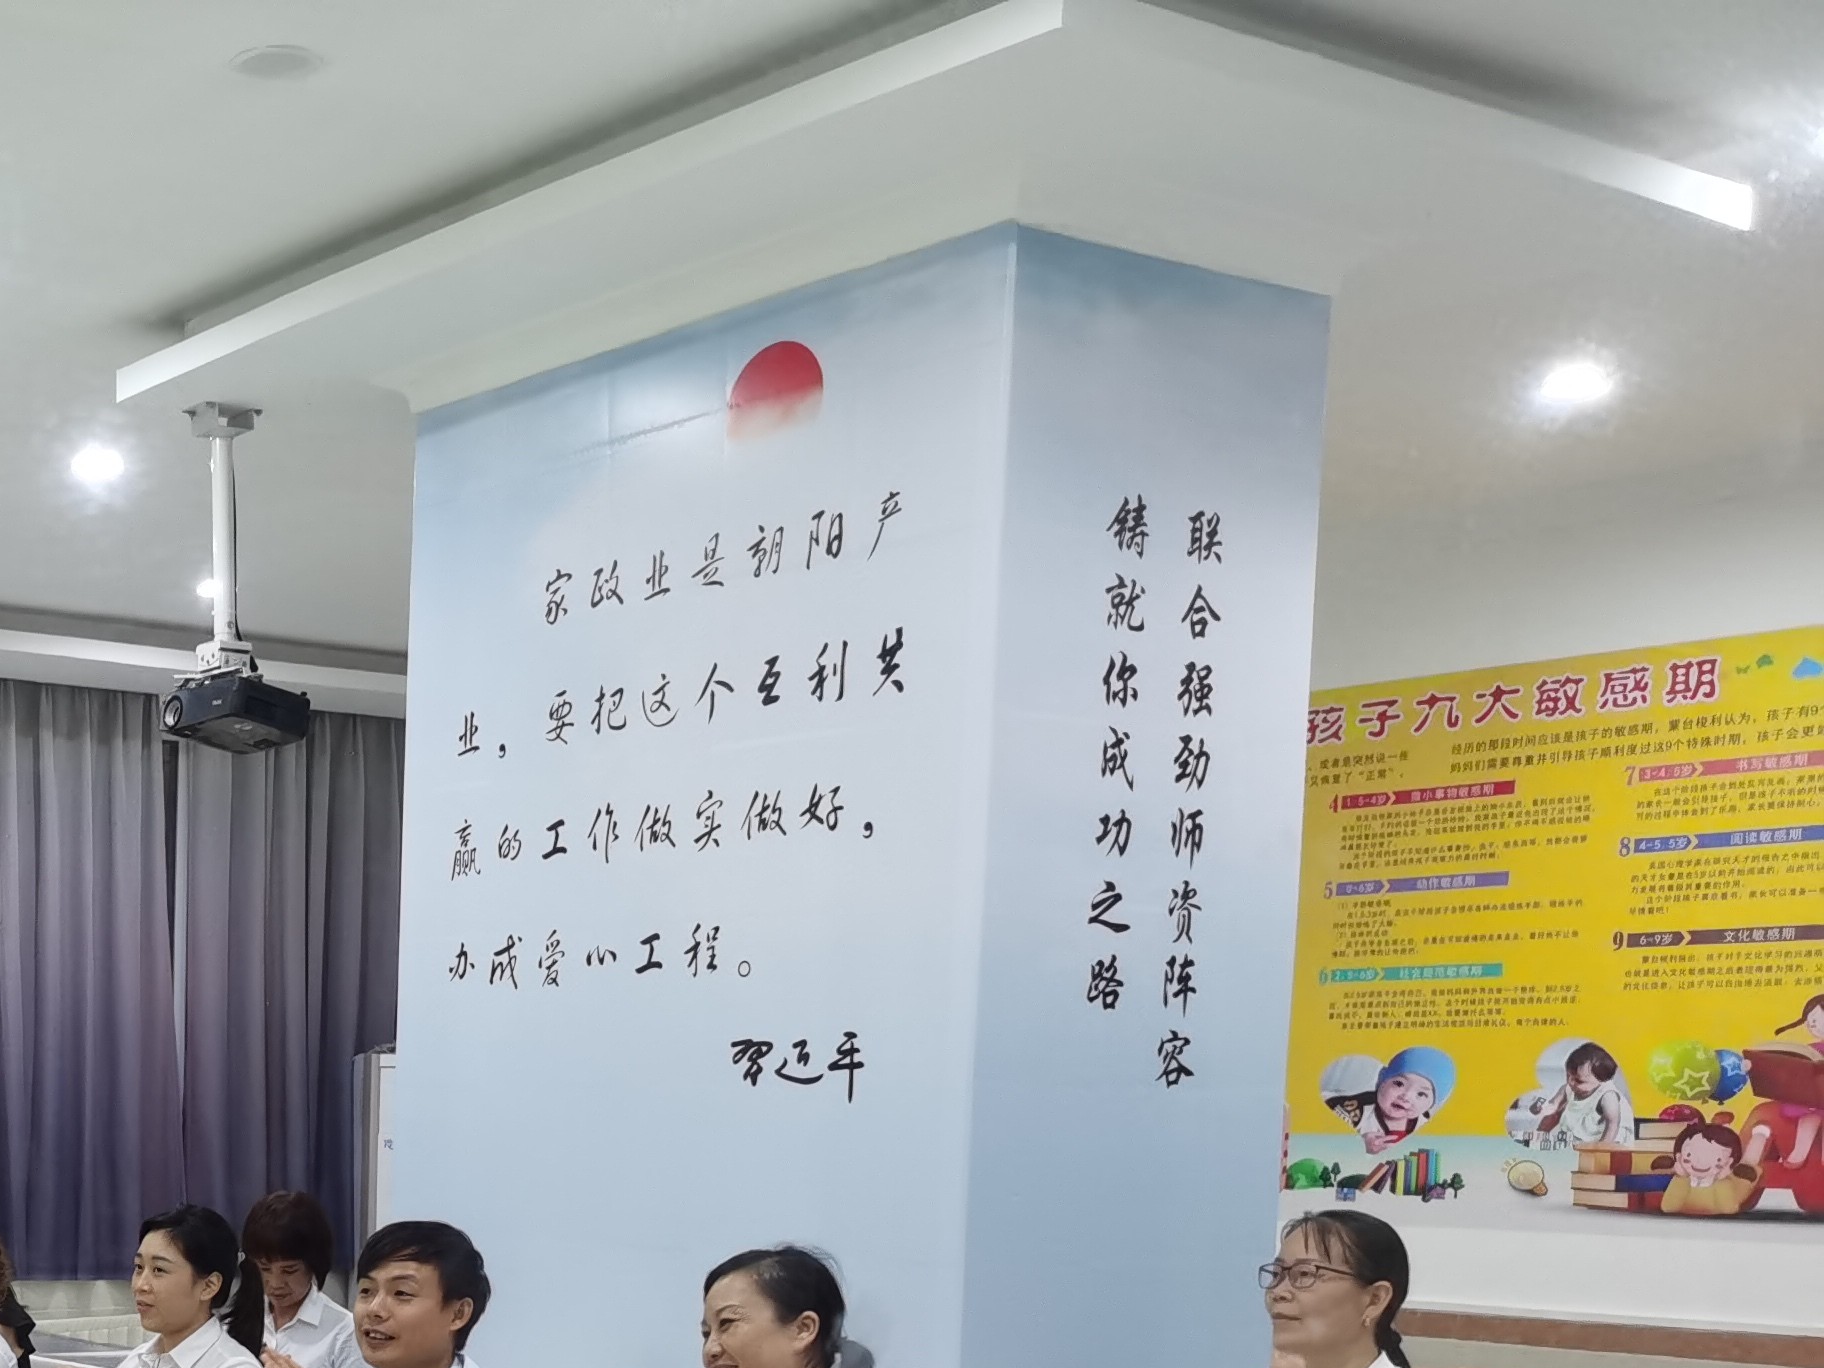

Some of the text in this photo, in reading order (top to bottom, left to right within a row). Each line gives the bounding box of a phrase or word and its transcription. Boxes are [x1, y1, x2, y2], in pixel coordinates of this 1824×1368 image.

[543, 490, 903, 626] 家政业是朝阳产
[457, 626, 905, 760] 业，要把这个互利共
[1307, 656, 1720, 746] 孩子九大敏感期
[1085, 492, 1150, 1011] 铸就你成功之路
[1735, 753, 1808, 771] 书写敏感期
[450, 782, 874, 882] 赢的工作做实做好，
[1154, 509, 1223, 1090] 联合强劲师资阵容
[1619, 836, 1631, 858] 8
[1730, 828, 1803, 846] 阅读敏感期
[448, 922, 753, 991] 办成爱心工程。
[1613, 931, 1624, 951] 9
[1723, 926, 1796, 943] 文化敏感期
